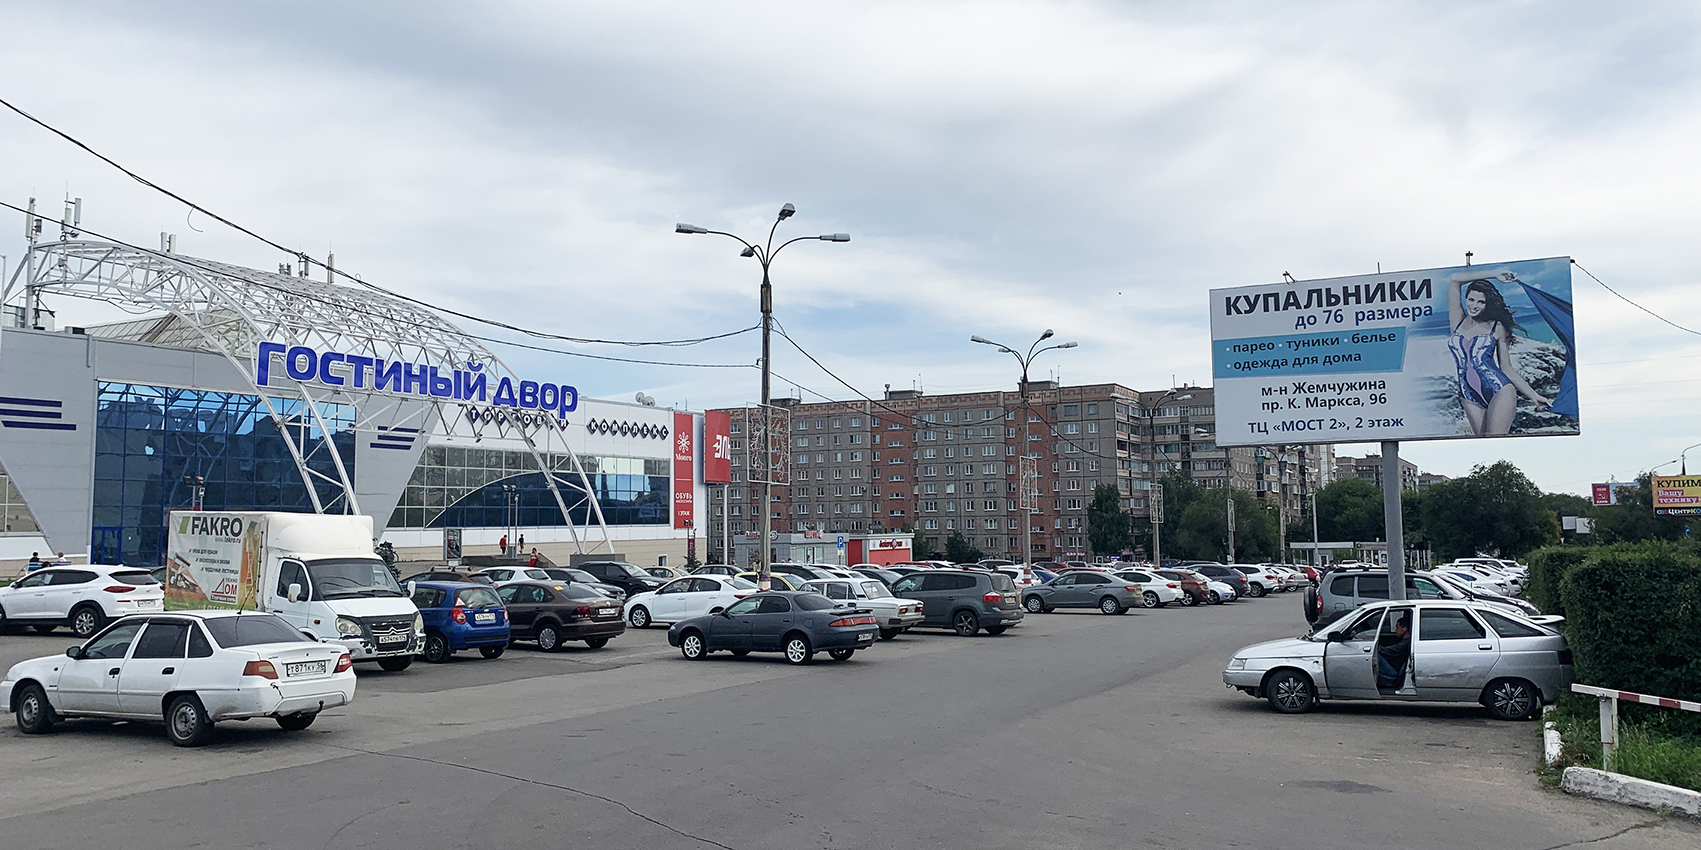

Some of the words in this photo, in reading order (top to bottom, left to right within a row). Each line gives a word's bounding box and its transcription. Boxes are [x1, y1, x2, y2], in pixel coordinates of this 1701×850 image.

[1225, 278, 1433, 316] КУПАЛЬНИКИ
[1295, 315, 1318, 330] до
[1323, 309, 1344, 325] 76
[1355, 305, 1433, 326] размера
[1233, 342, 1275, 355] парео
[1286, 337, 1340, 351] туники
[1352, 332, 1396, 345] белье
[256, 341, 487, 403] ГОСТИНЫЙ
[1233, 359, 1288, 372] одежда
[1292, 356, 1319, 368] для
[1323, 353, 1362, 366] дома
[1262, 383, 1288, 397] м-н
[1292, 380, 1386, 397] Жемчужина
[1261, 401, 1283, 413] пр.
[1288, 398, 1301, 410] К.
[1306, 396, 1365, 411] Маркса,
[1370, 393, 1387, 406] 96
[469, 408, 568, 430] ТОРОВЙ
[589, 419, 668, 439] КОМПЛЕКС
[1248, 420, 1269, 435] ТЦ
[1273, 419, 1324, 433] «МОСТ
[1330, 418, 1350, 431] 2»,
[1355, 417, 1363, 429] 2
[1368, 416, 1404, 429] этаж
[1657, 479, 1701, 488] КУПИМ
[675, 492, 692, 500] ОБУВЬ
[1658, 490, 1683, 498] Вашу
[1658, 497, 1697, 505] технику
[191, 516, 243, 537] FAKRO
